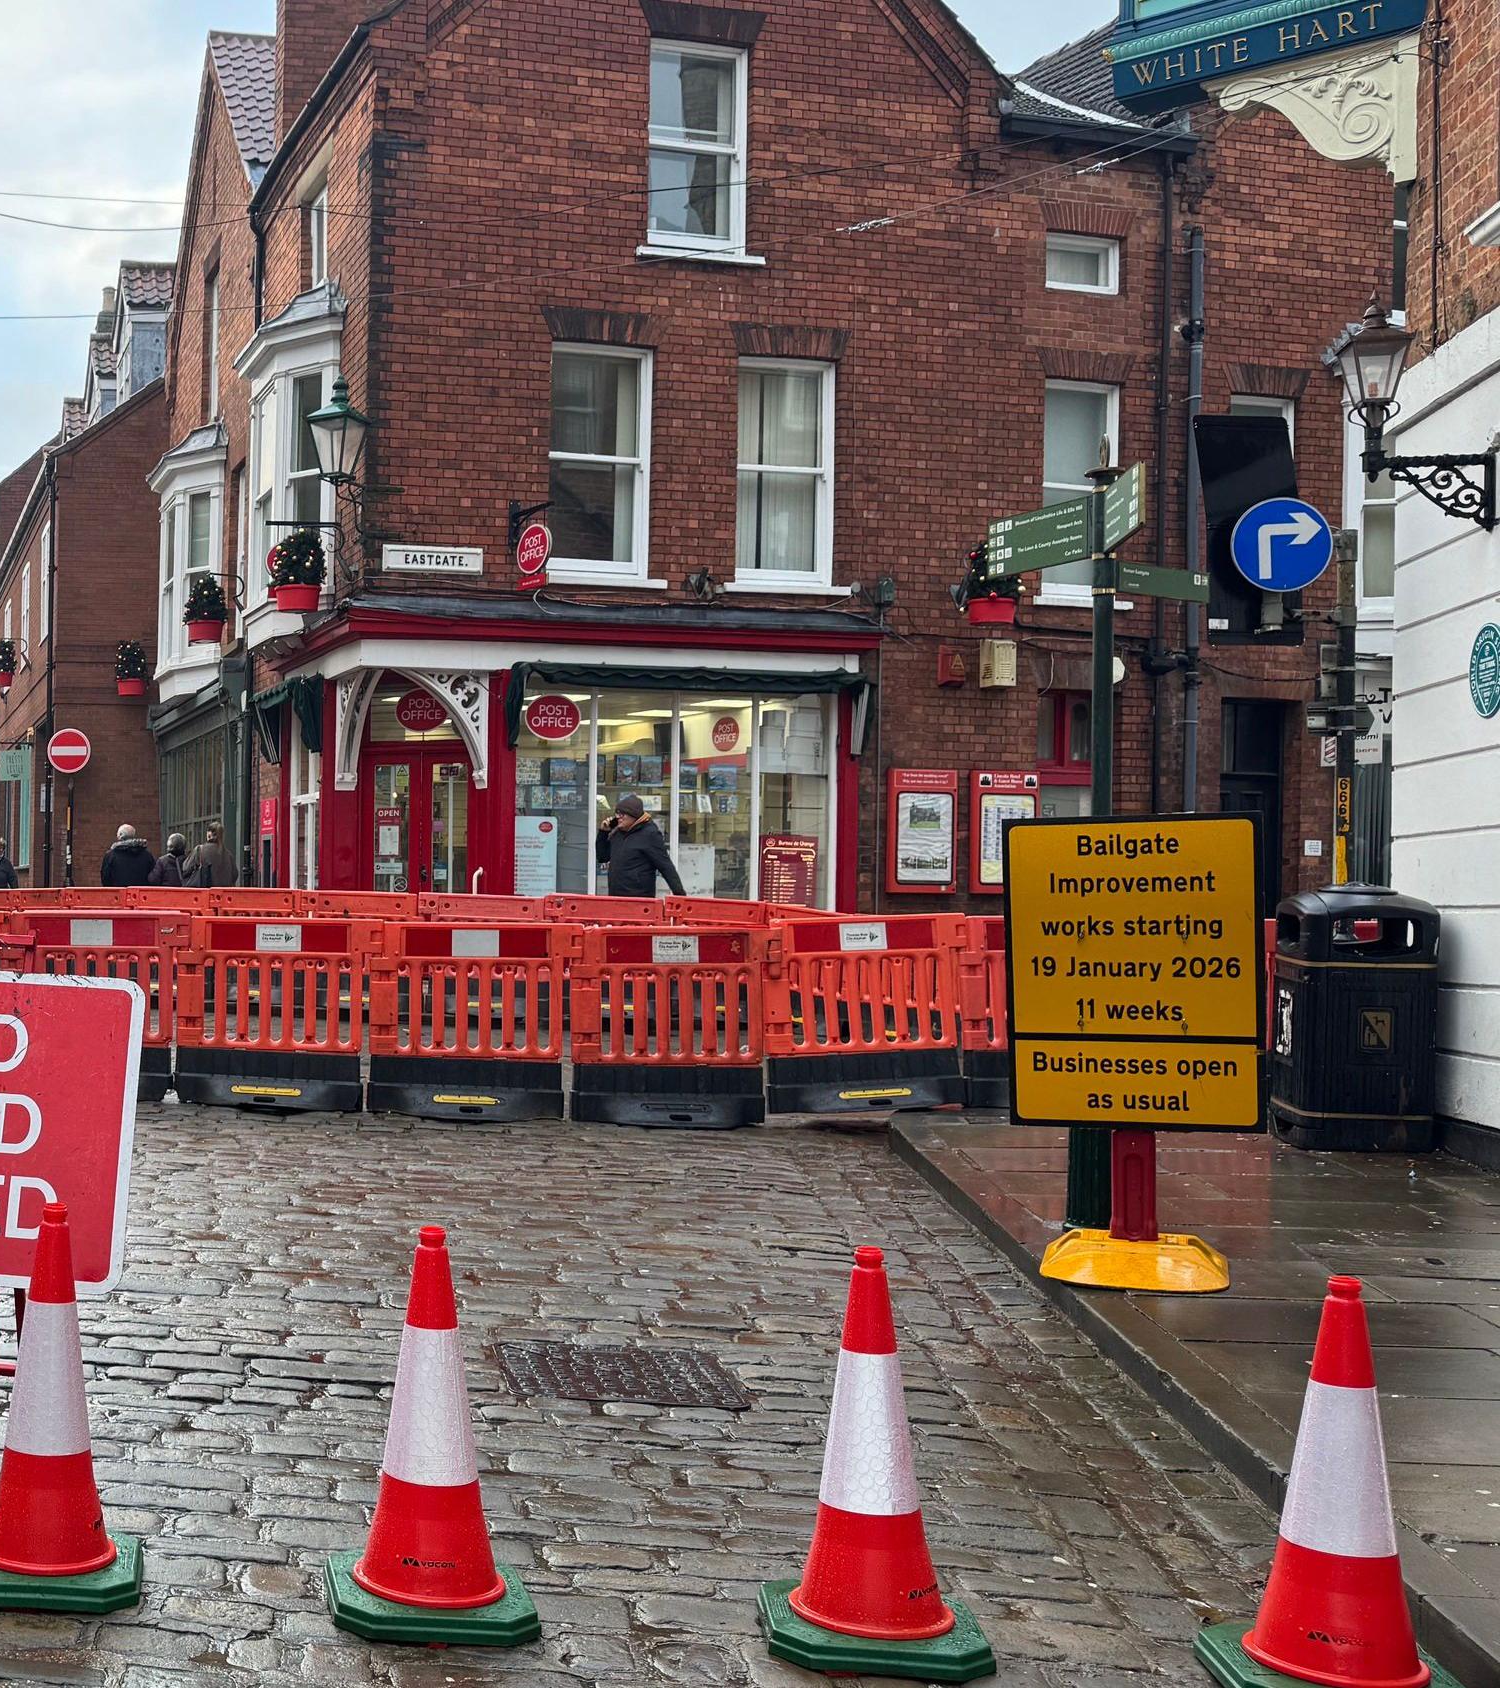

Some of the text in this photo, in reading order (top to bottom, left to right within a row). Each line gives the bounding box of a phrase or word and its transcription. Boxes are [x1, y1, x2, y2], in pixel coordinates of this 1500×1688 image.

[1131, 2, 1383, 87] WHITE HART
[524, 533, 542, 549] POST
[404, 553, 469, 567] EASTGATE.
[520, 545, 545, 563] OFFICE
[408, 699, 437, 709] POST
[539, 704, 570, 715] POST
[401, 709, 442, 721] OFFICE
[531, 716, 573, 728] OFFICE
[717, 723, 734, 734] POST
[714, 733, 736, 744] OFFICE
[378, 809, 400, 817] OPEN
[1077, 833, 1180, 859] Bailgate
[1050, 870, 1216, 897] Improvement
[1041, 914, 1223, 939] works starting
[1031, 955, 1241, 982] 19 January 2026
[1076, 998, 1183, 1021] 11 weeks
[1032, 1050, 1238, 1080] Businesses open
[1086, 1090, 1190, 1112] as usual
